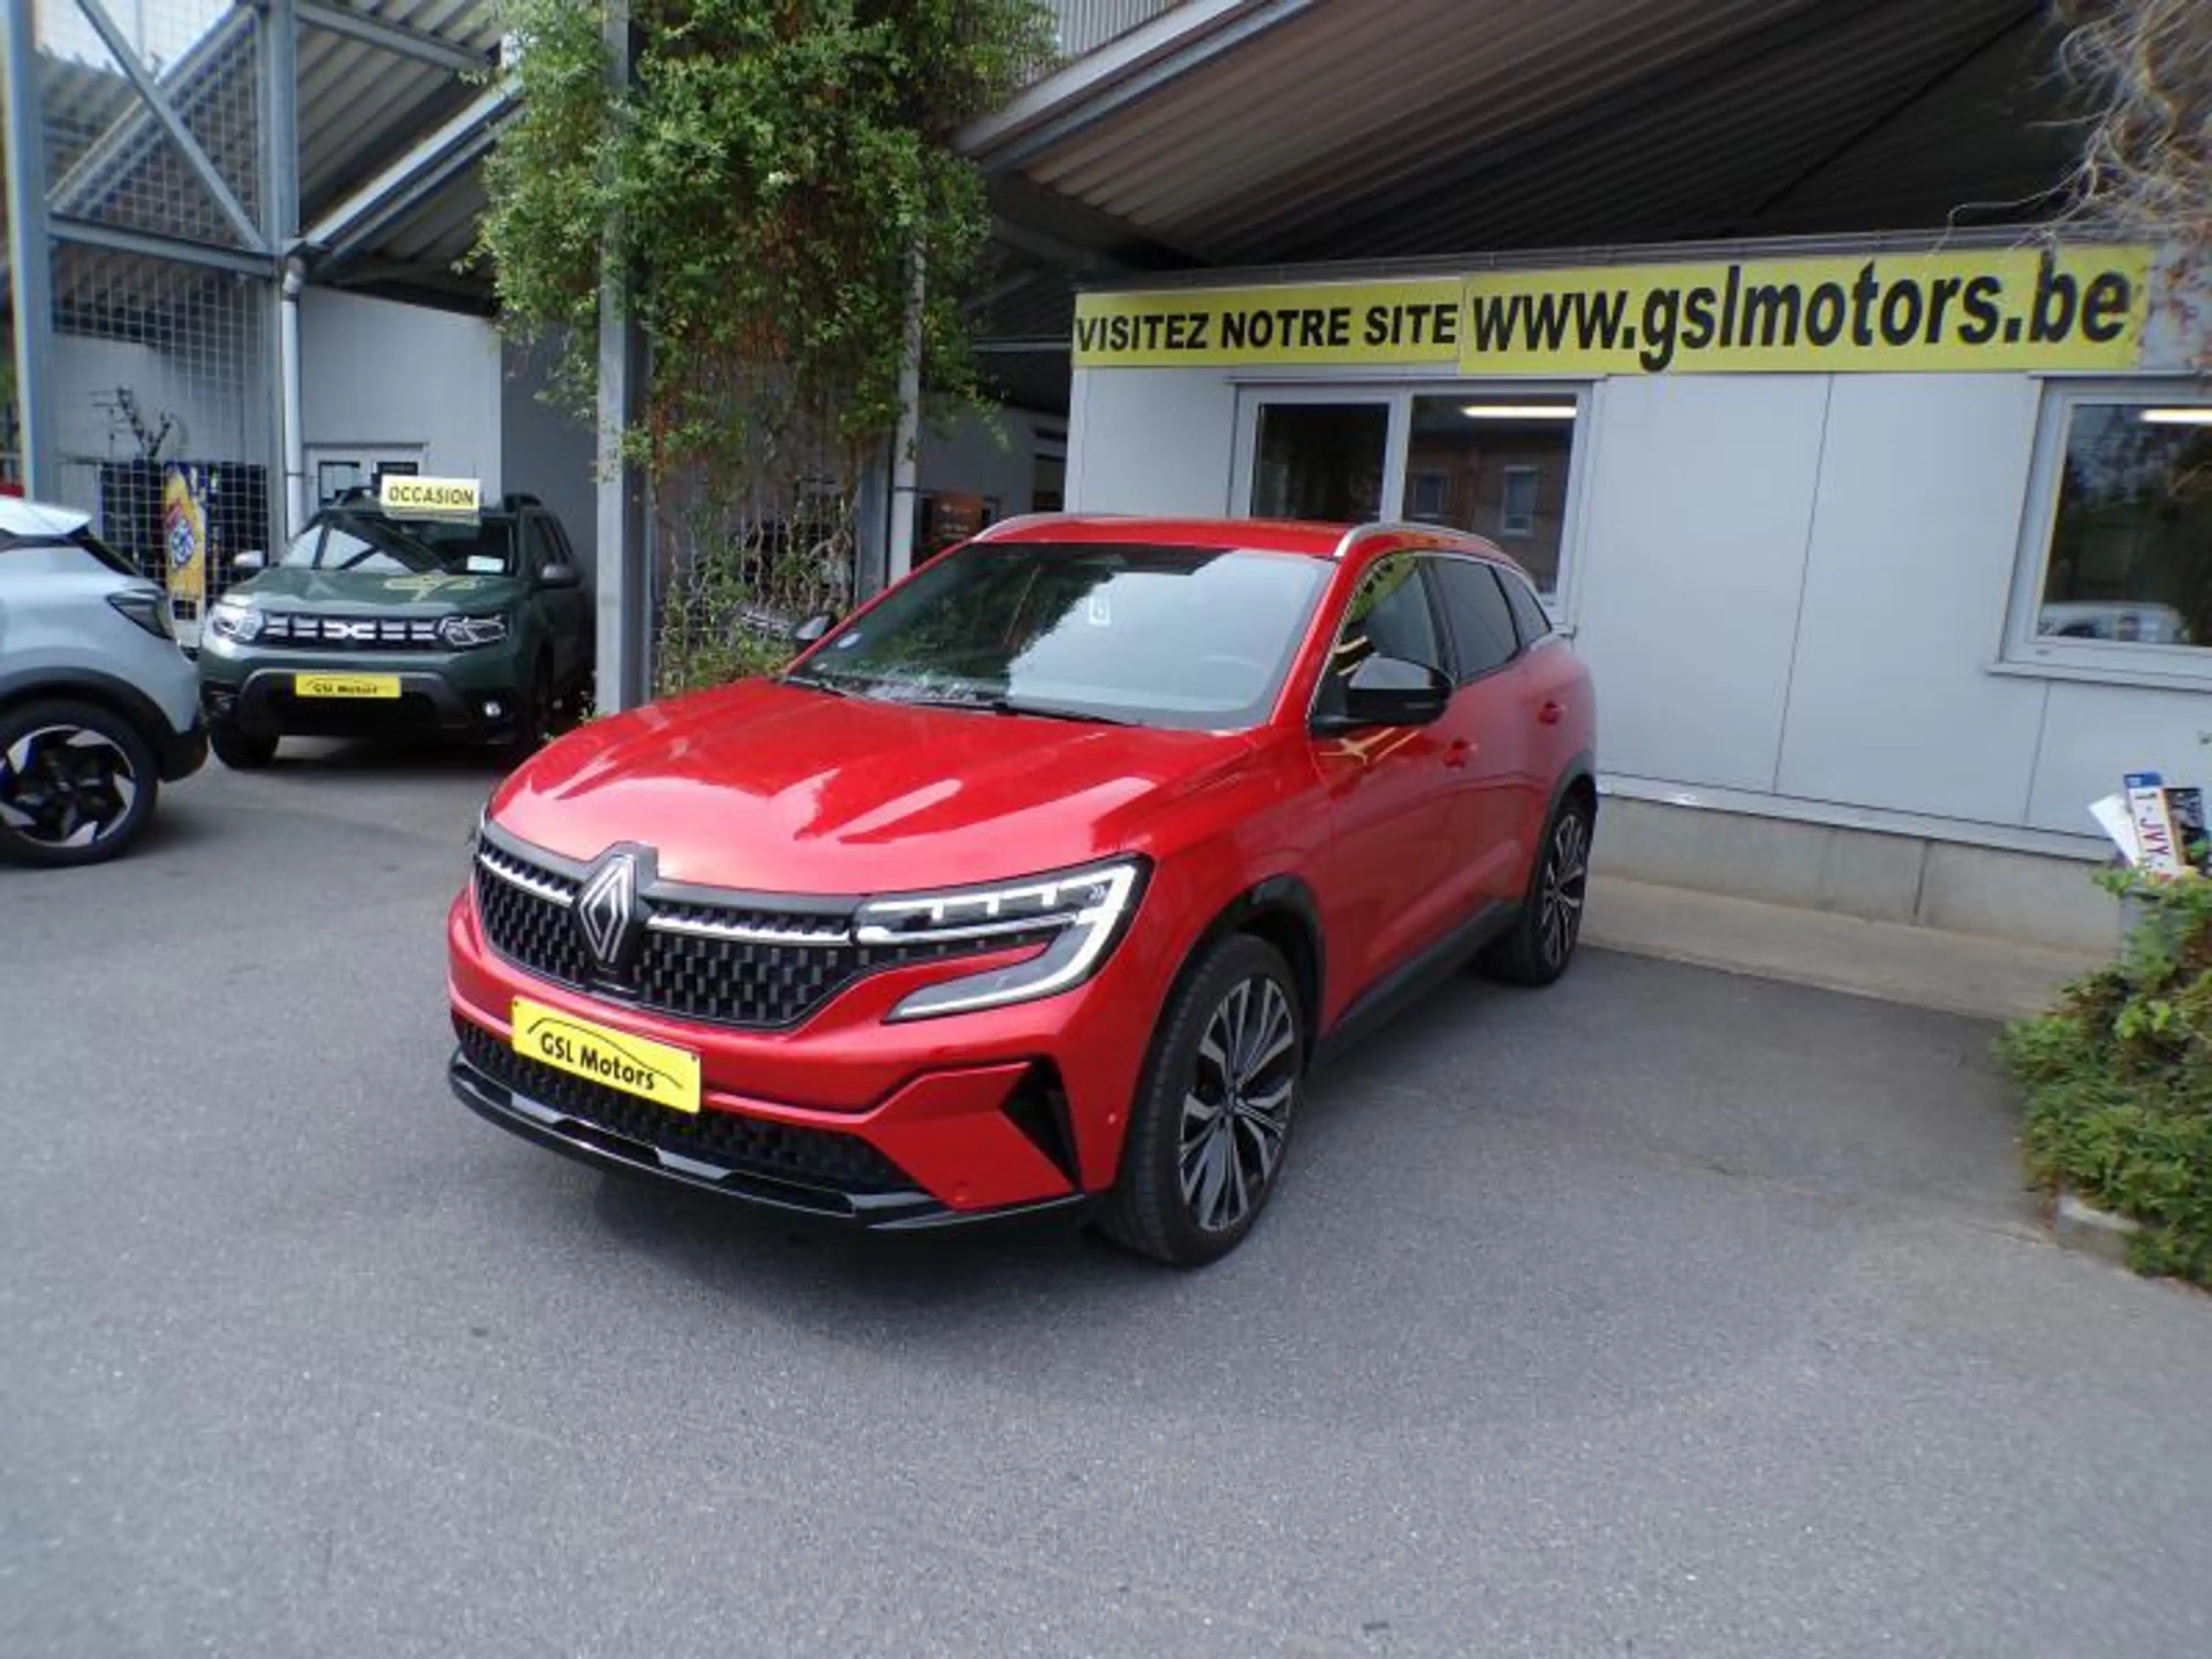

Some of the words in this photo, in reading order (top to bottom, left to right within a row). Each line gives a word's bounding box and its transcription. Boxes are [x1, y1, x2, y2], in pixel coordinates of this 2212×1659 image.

[1077, 313, 1209, 351] VISITEZ
[1221, 307, 1350, 349] NOTRE
[1364, 304, 1458, 346] SITE
[1473, 250, 2130, 373] www.gslmotors.be
[389, 486, 474, 506] OCCASION
[540, 1032, 573, 1063] GSL
[580, 1046, 656, 1090] Motors
